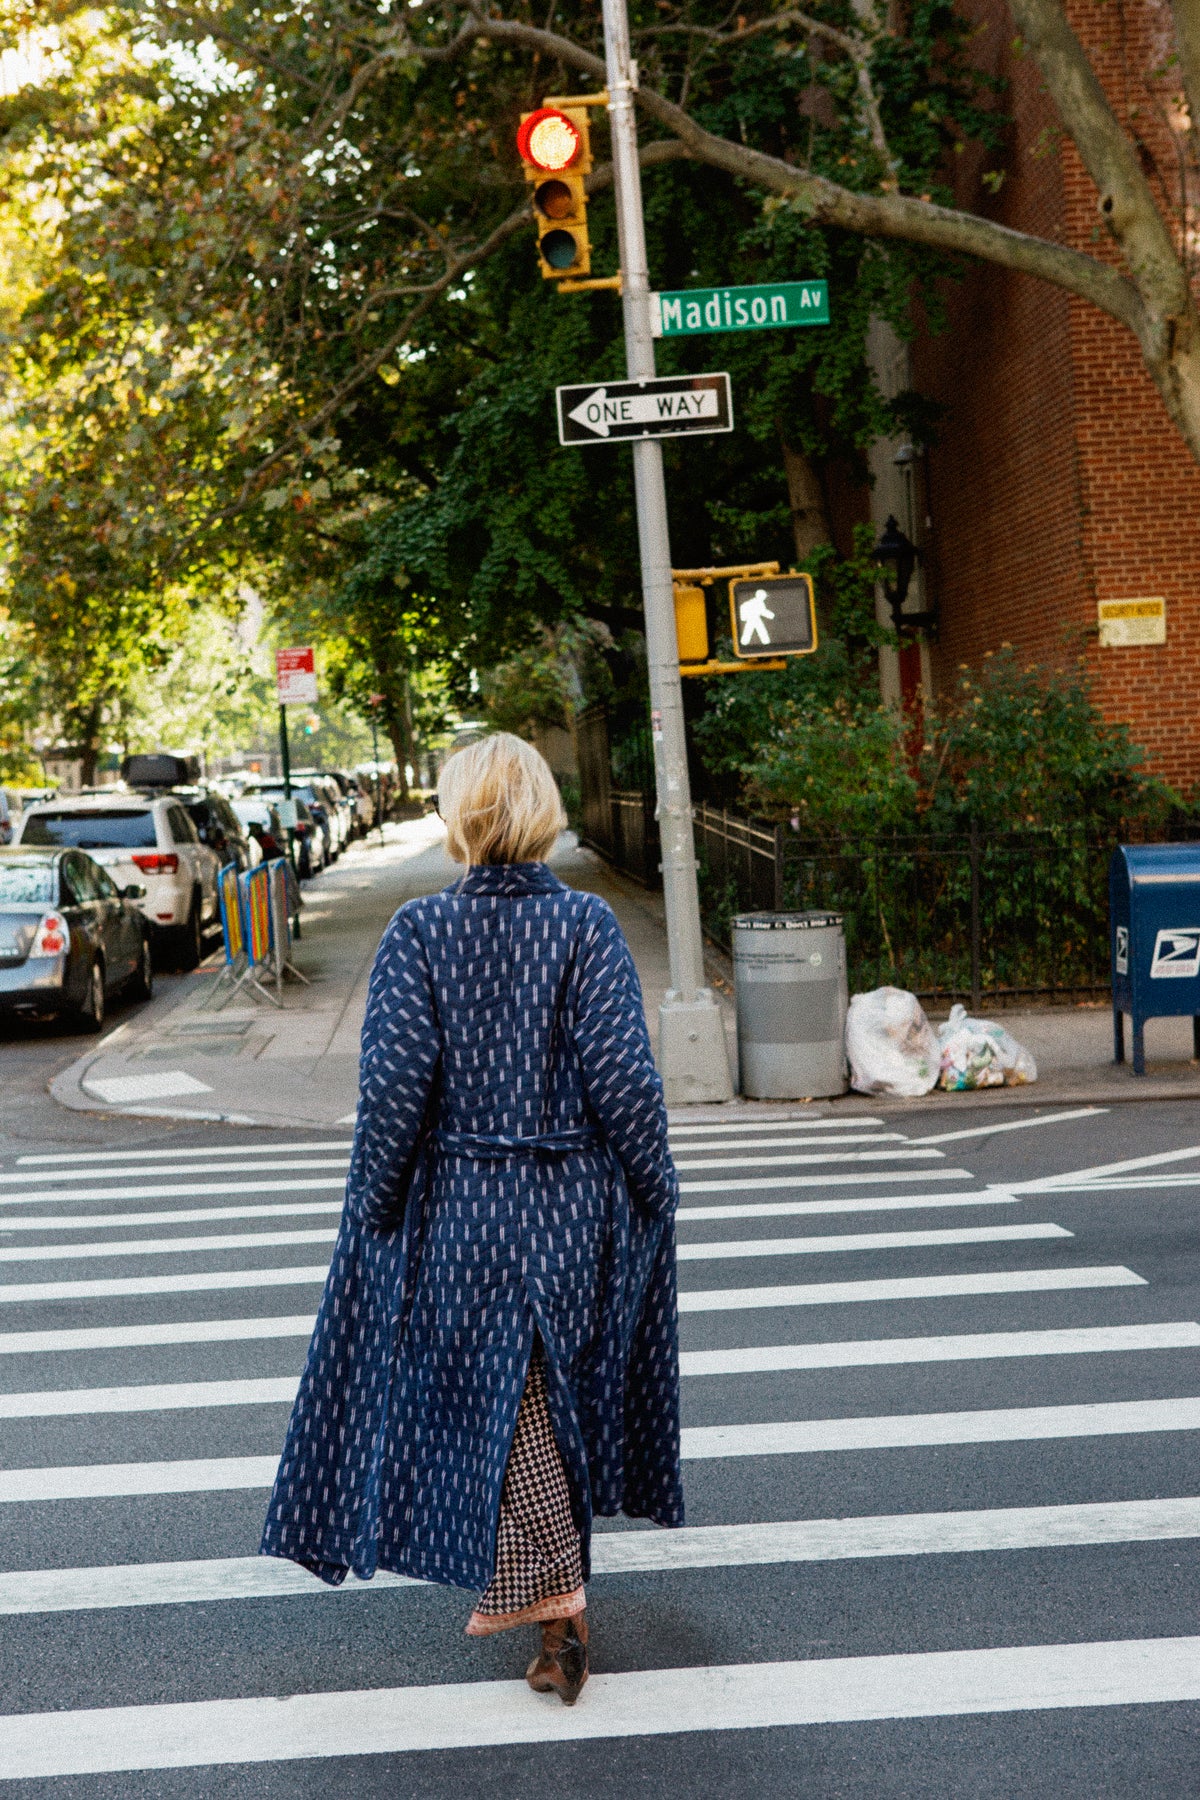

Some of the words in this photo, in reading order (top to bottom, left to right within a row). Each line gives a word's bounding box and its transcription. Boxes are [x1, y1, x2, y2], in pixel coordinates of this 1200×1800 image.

[662, 291, 788, 331] Madison
[586, 400, 633, 424] ONE
[656, 394, 706, 418] WAY
